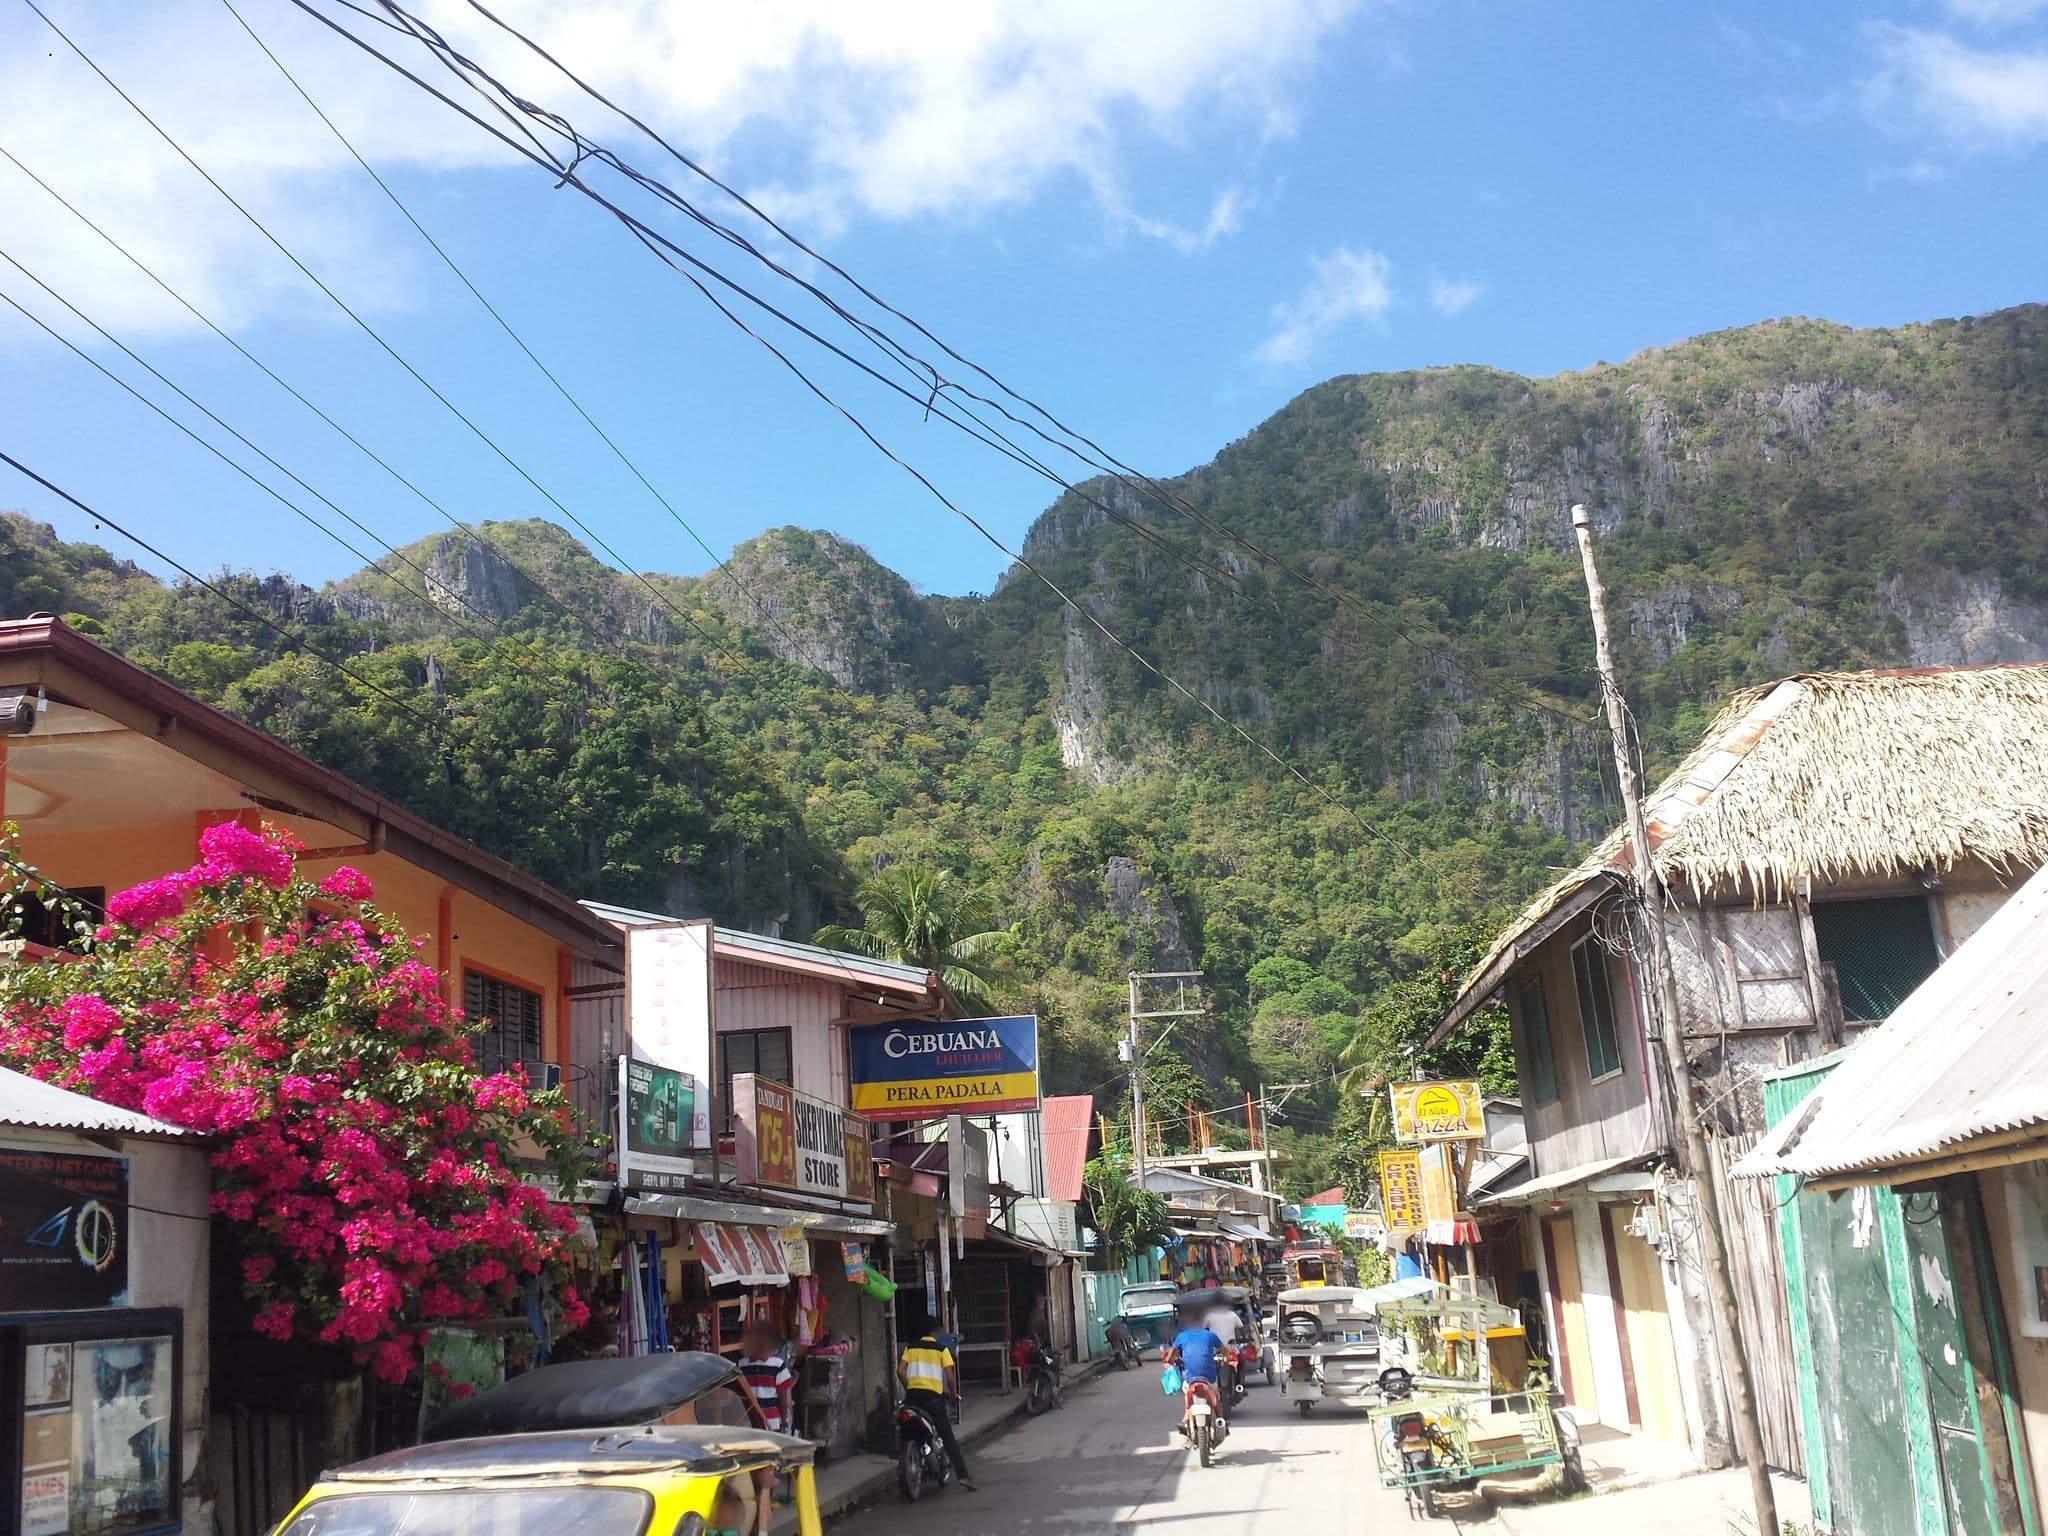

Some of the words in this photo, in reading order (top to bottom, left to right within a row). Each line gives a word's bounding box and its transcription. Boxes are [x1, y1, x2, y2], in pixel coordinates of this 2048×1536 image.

[884, 1028, 1002, 1058] CEBUANA
[757, 1087, 784, 1112] TANDUAY
[887, 1085, 931, 1101] PERA
[935, 1081, 1003, 1099] PADALA
[805, 1157, 840, 1187] STORE
